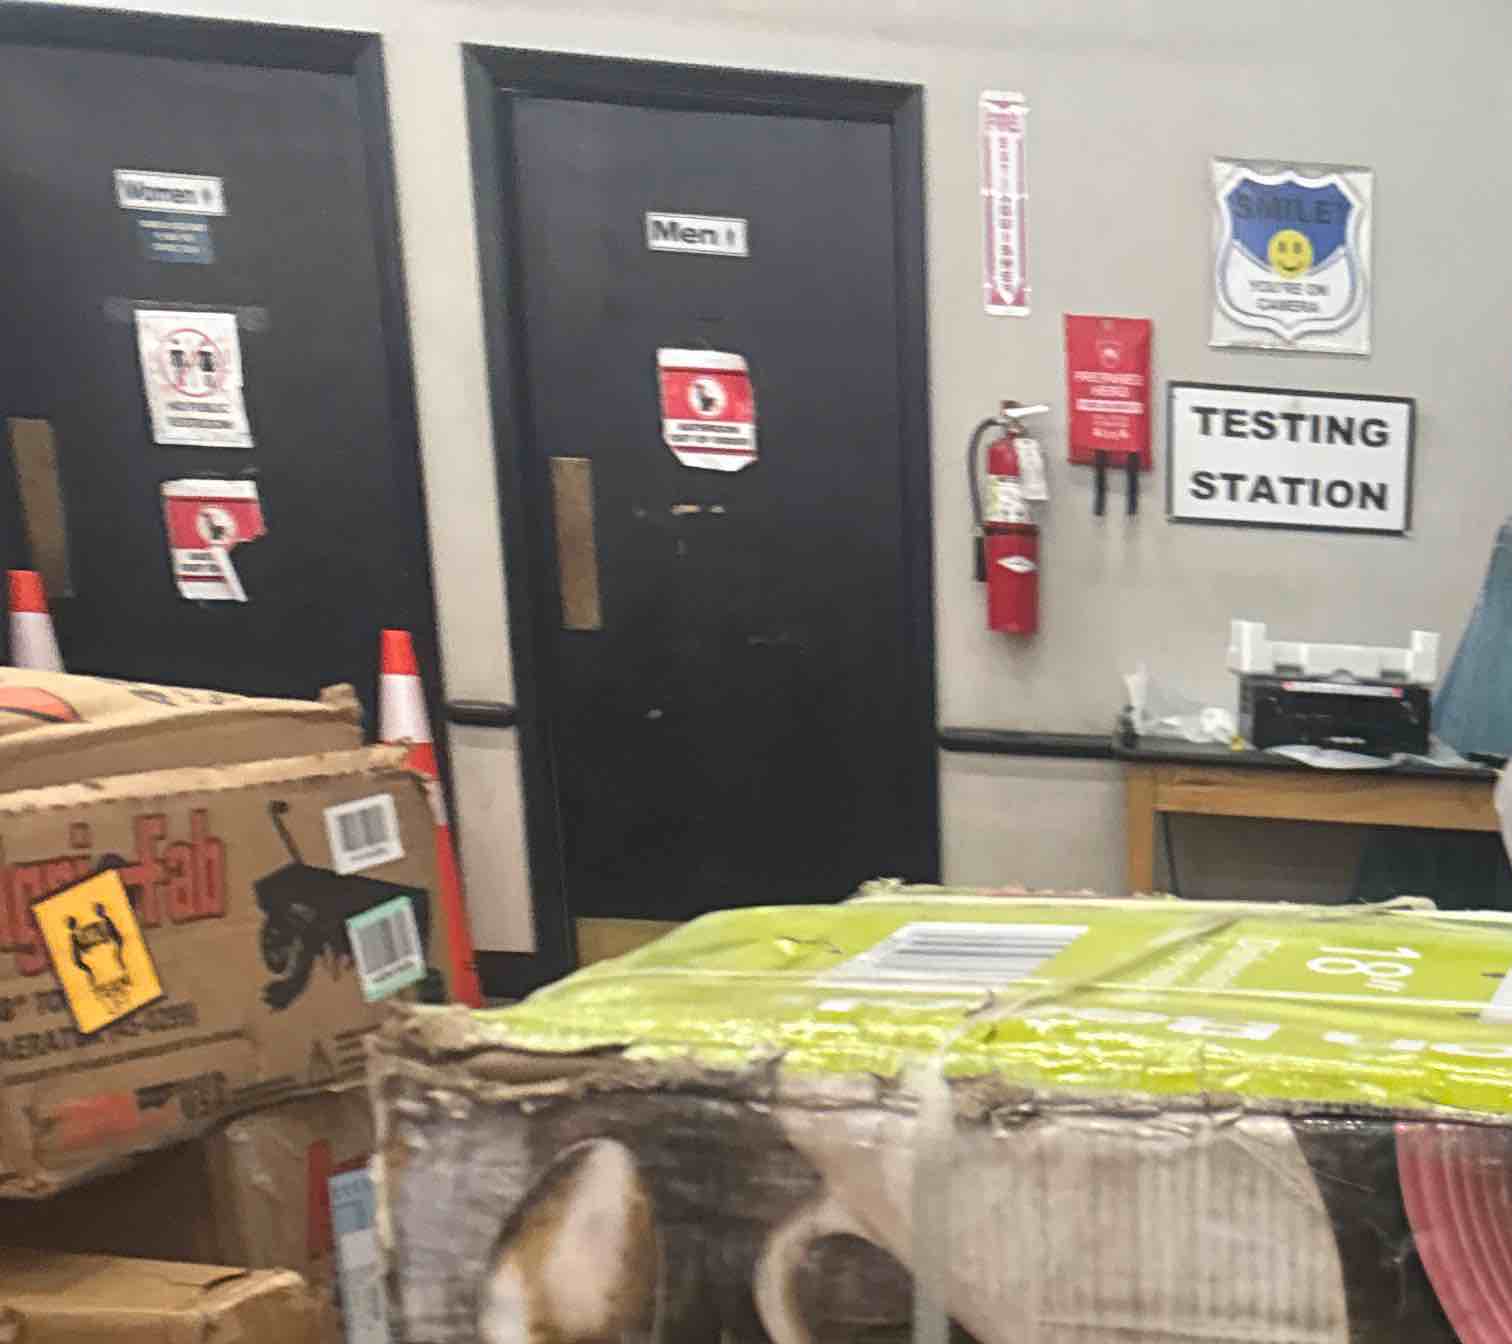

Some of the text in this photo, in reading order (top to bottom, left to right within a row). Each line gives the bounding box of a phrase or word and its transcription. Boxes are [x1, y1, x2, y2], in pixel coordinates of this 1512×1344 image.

[652, 220, 719, 246] Men
[1190, 405, 1390, 448] TESTING
[1190, 470, 1389, 511] STATION
